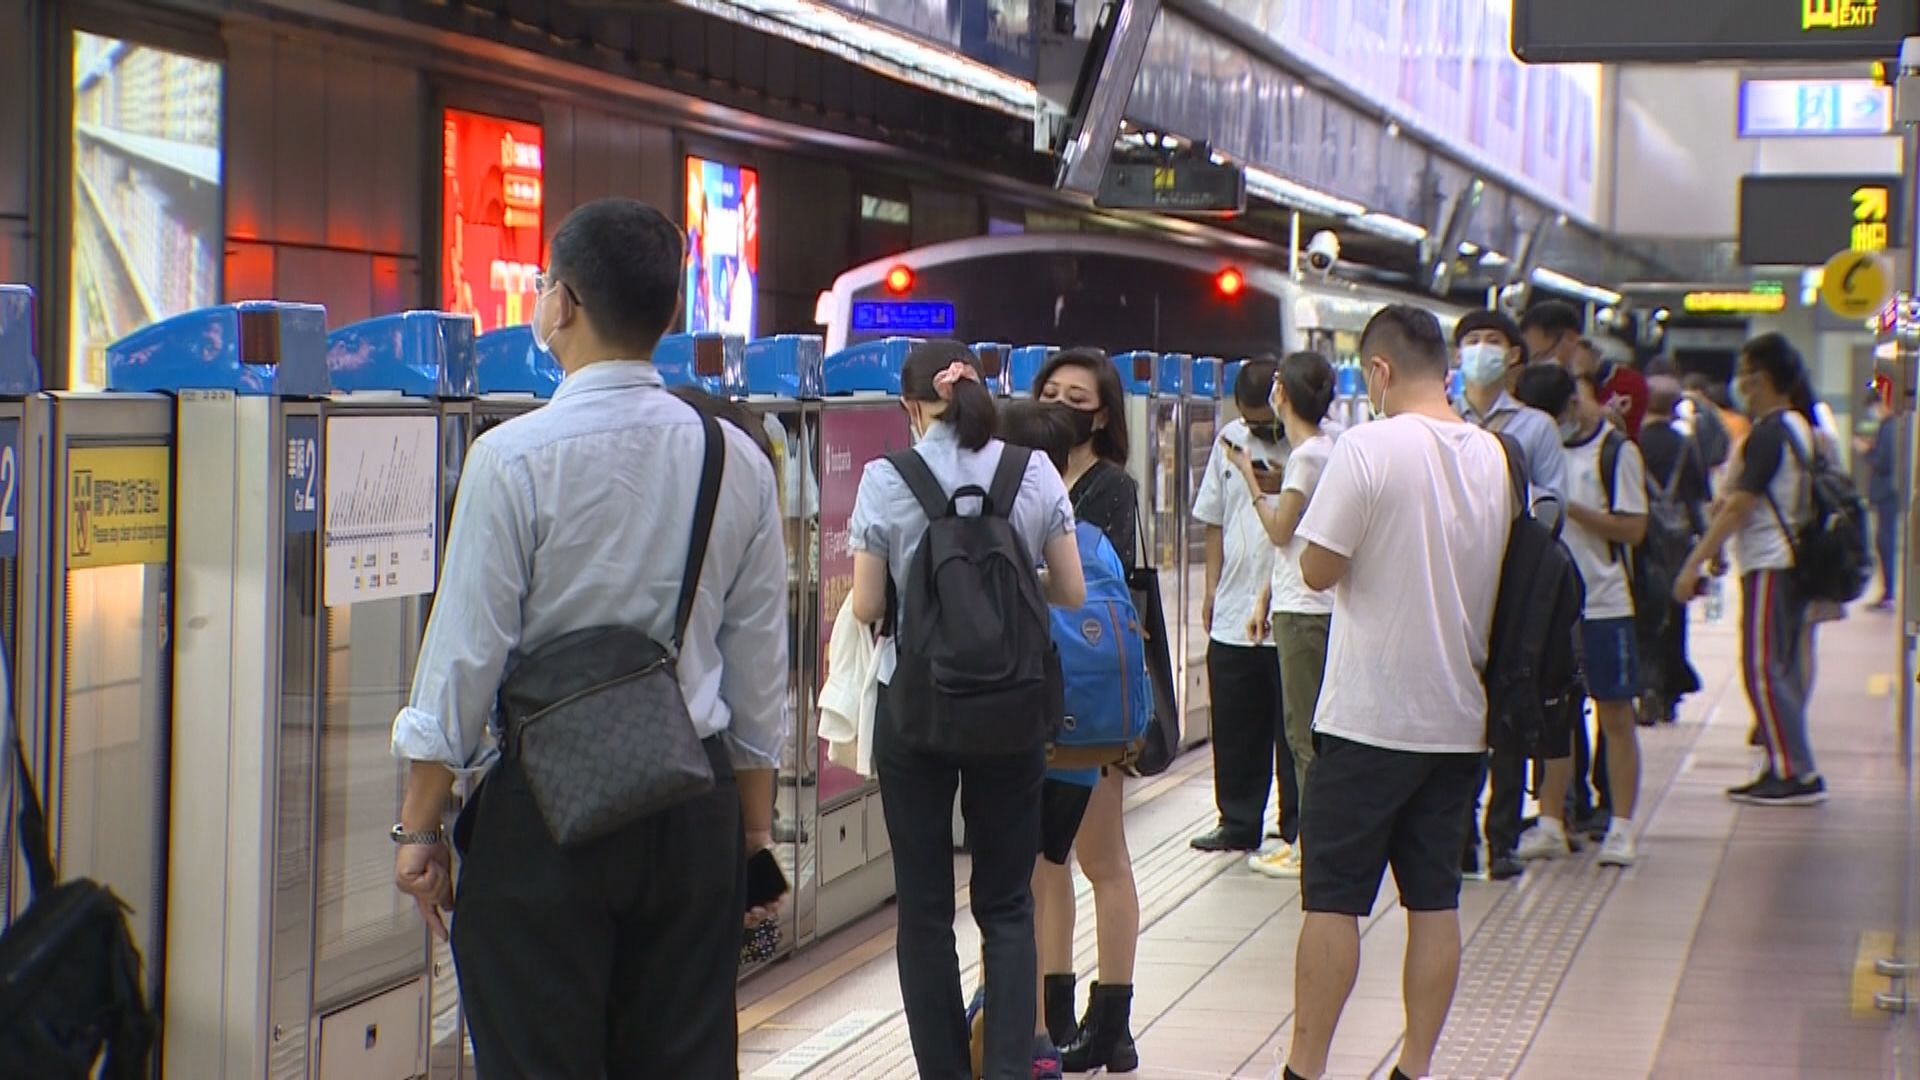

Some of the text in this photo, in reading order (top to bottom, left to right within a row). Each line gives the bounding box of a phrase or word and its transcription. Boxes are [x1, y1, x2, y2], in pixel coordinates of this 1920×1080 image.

[1840, 6, 1877, 25] EXIT
[0, 445, 15, 531] 2
[304, 438, 316, 531] 2
